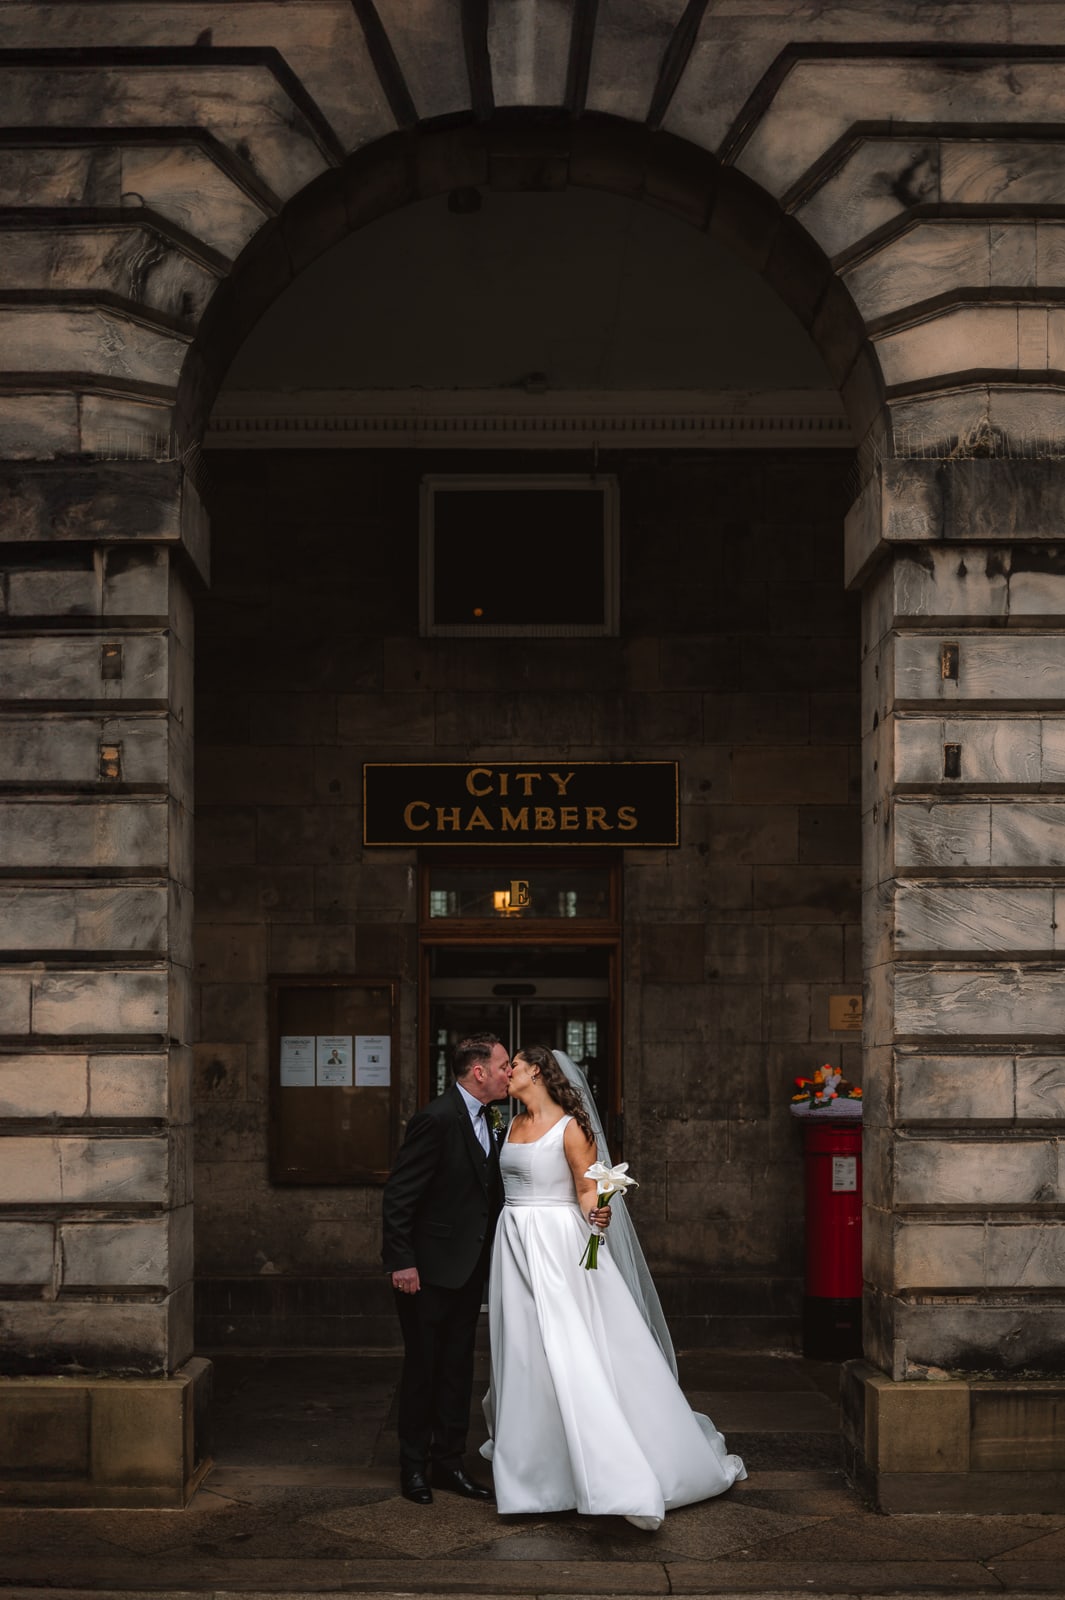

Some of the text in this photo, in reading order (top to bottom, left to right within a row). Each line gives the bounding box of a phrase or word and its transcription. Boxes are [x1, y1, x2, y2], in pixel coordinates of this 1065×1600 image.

[466, 768, 576, 797] CITY
[403, 801, 638, 831] CHAMBERS
[508, 880, 531, 908] E
